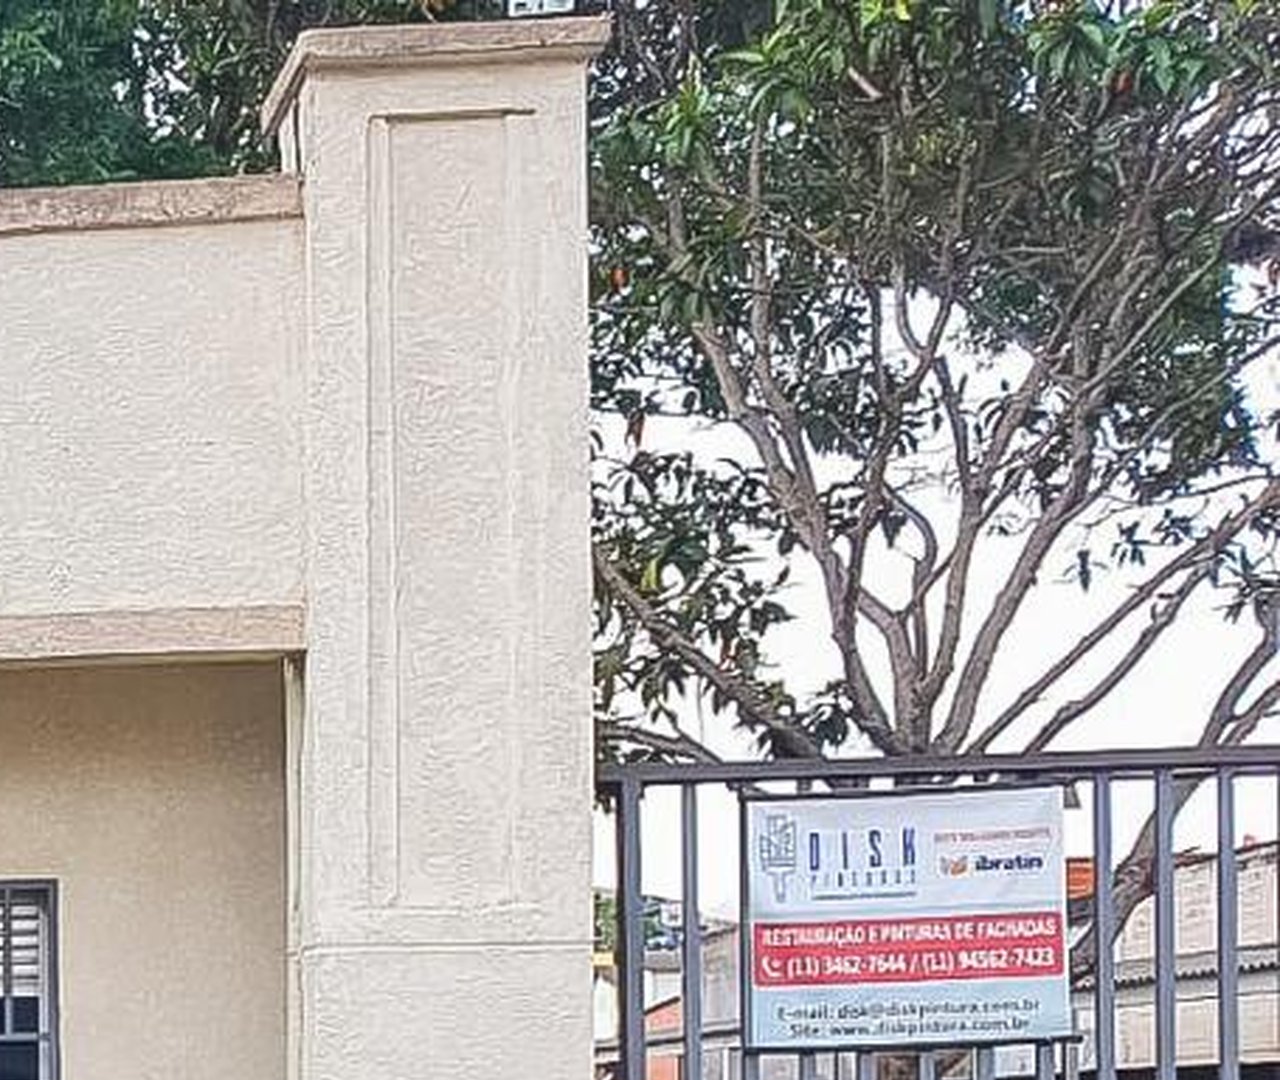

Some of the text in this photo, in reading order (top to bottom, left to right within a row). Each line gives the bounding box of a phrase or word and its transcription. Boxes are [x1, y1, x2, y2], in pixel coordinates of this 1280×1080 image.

[809, 827, 916, 871] DISK
[868, 924, 878, 943] E
[879, 921, 952, 943] PINTURAS
[954, 921, 975, 940] DE
[976, 918, 1057, 938] FACHADAS
[786, 955, 820, 980] (11)
[922, 950, 955, 976] (11)
